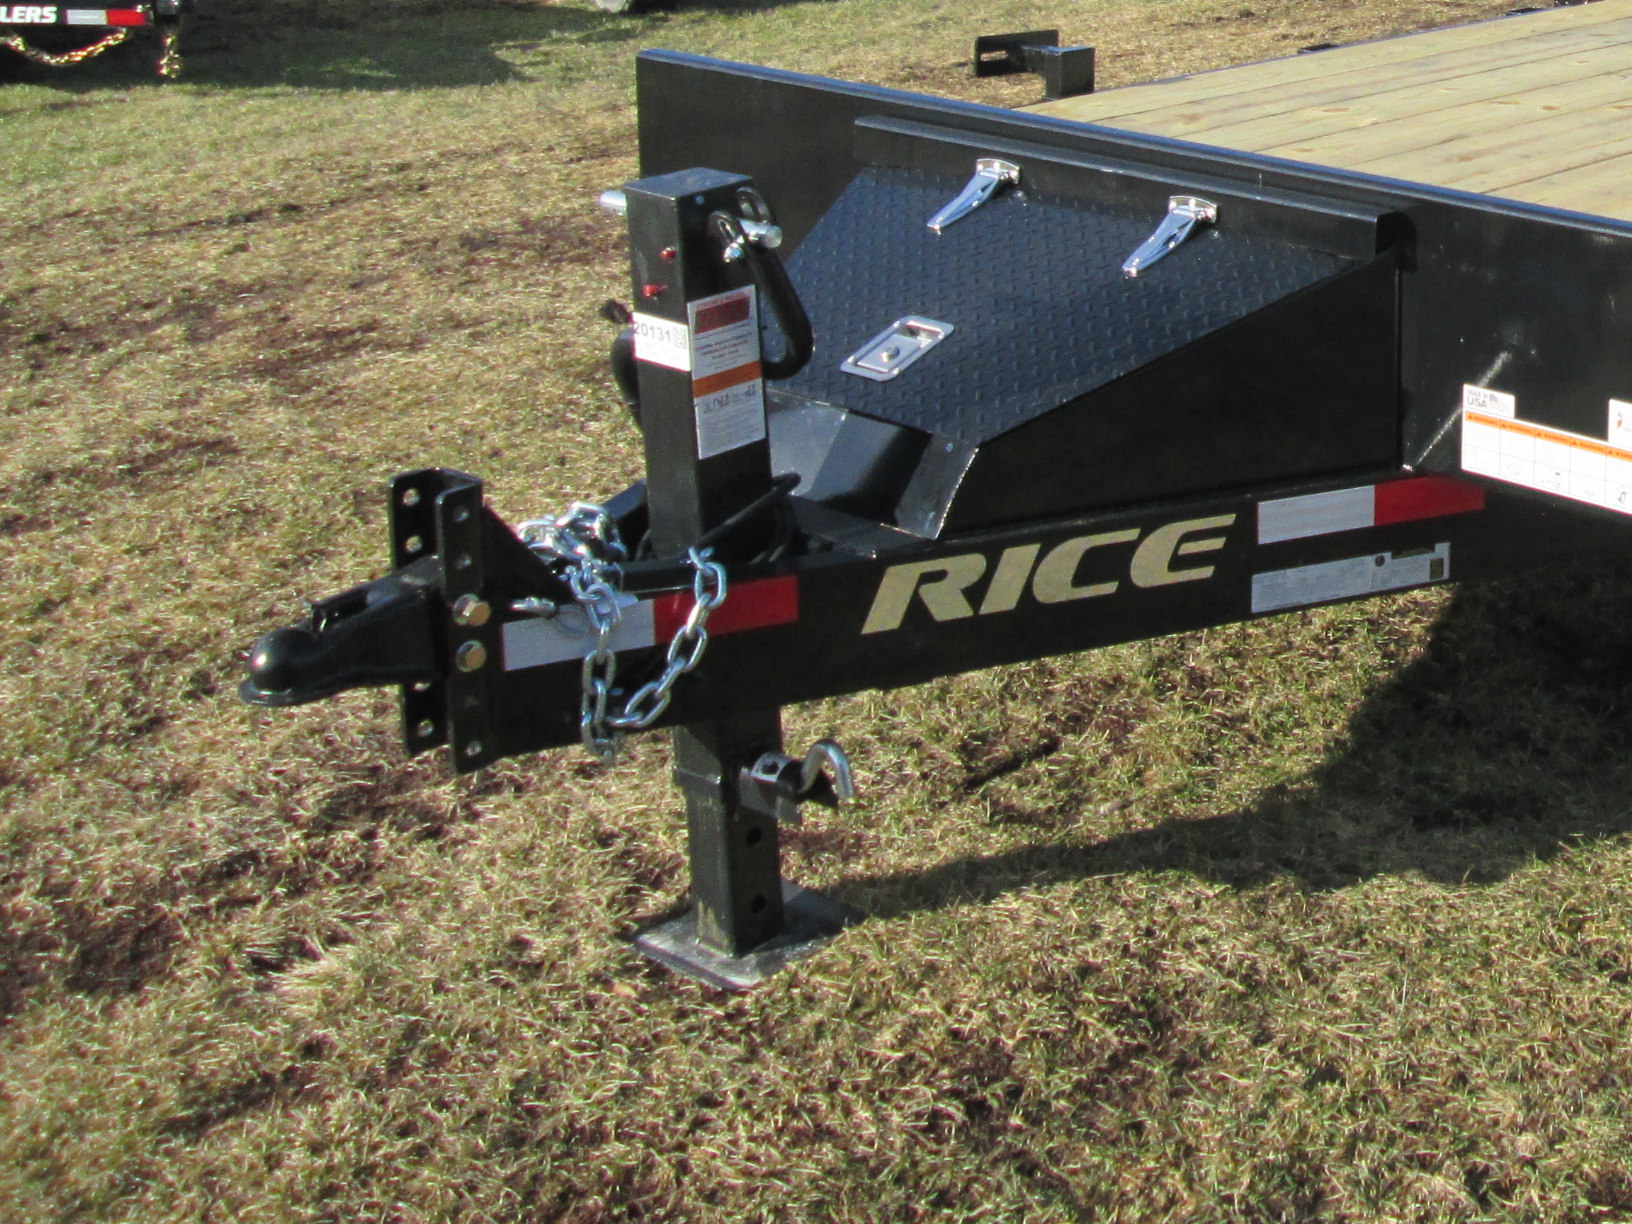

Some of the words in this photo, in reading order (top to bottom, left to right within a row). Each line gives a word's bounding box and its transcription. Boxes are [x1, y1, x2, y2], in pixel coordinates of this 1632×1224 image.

[1467, 395, 1488, 409] USA
[1473, 415, 1499, 427] WARNING
[1508, 423, 1534, 435] WARNING
[1544, 432, 1570, 444] WARNING
[1579, 441, 1606, 454] WARNING
[861, 513, 1237, 635] RICE
